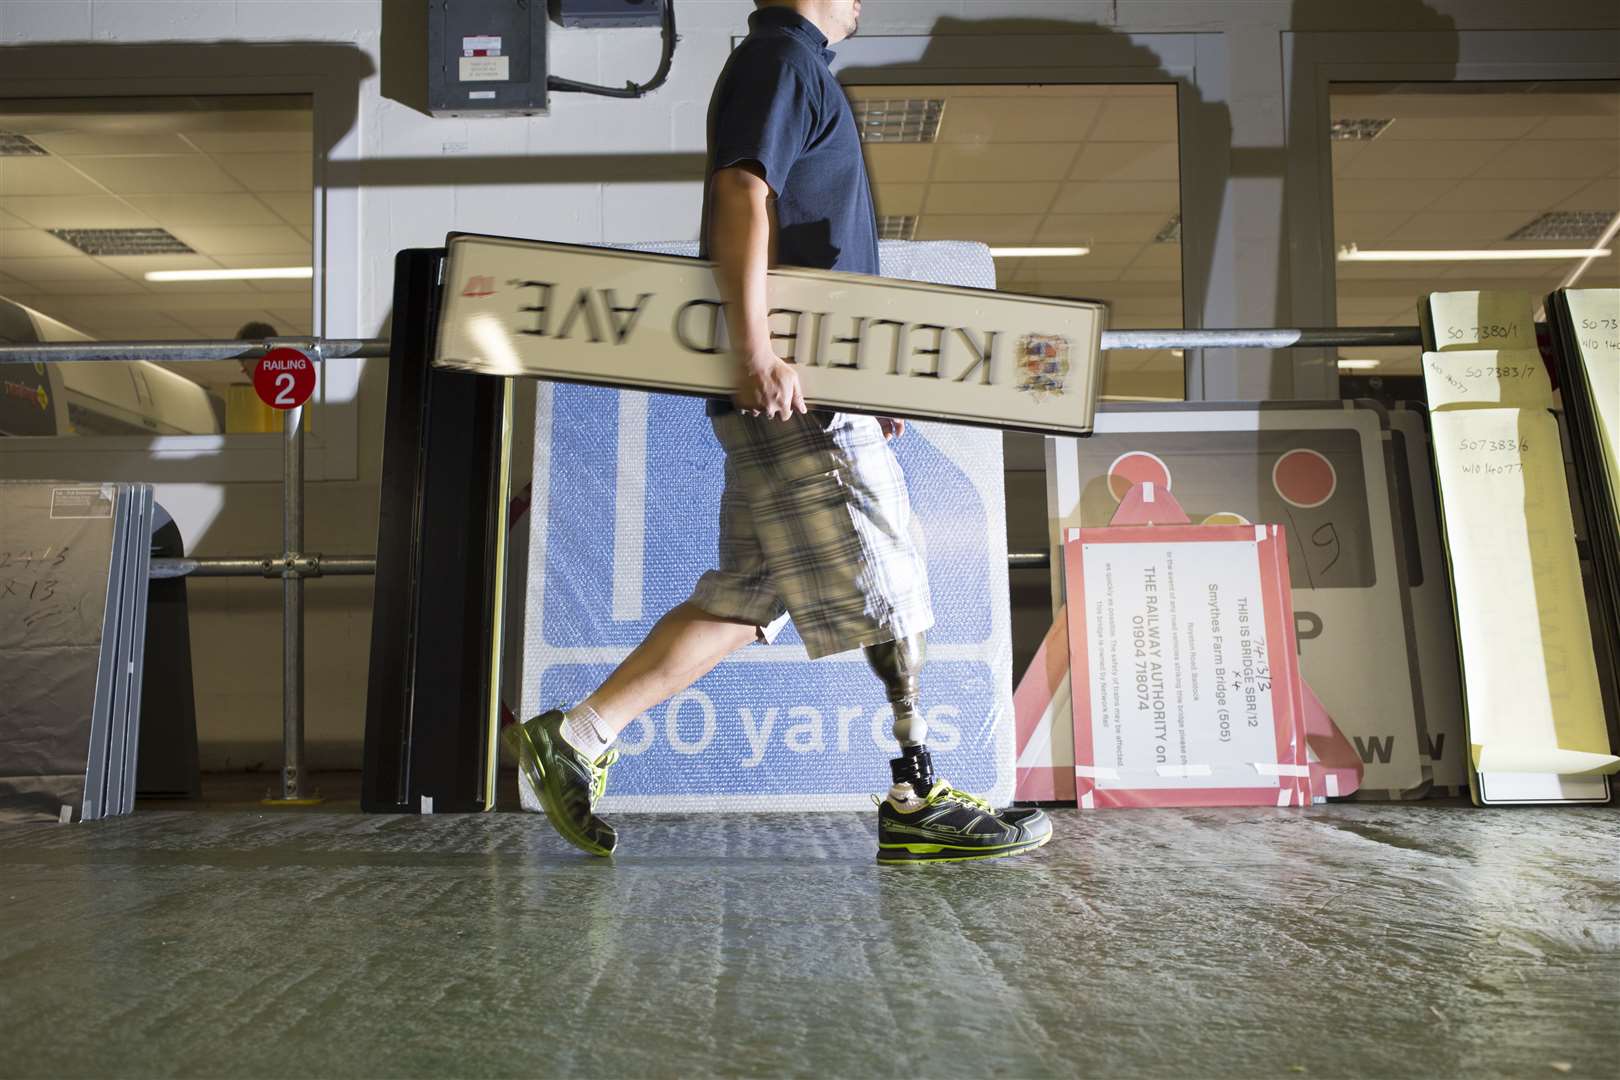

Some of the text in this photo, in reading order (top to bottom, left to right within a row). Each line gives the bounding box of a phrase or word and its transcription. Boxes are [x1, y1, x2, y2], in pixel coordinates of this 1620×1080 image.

[264, 360, 306, 370] RAILING
[674, 298, 1000, 390] KELFIED
[1470, 321, 1518, 338] 7380/1
[1486, 364, 1535, 379] 7383/7
[275, 373, 295, 404] 2
[1133, 616, 1149, 711] 01904 718074
[1144, 566, 1167, 763] THE RAILWAY AUTHORITY on
[1208, 584, 1231, 742] Smythes Farm Bridge (505)
[1237, 597, 1258, 727] THIS IS BRIDGE SBR/12
